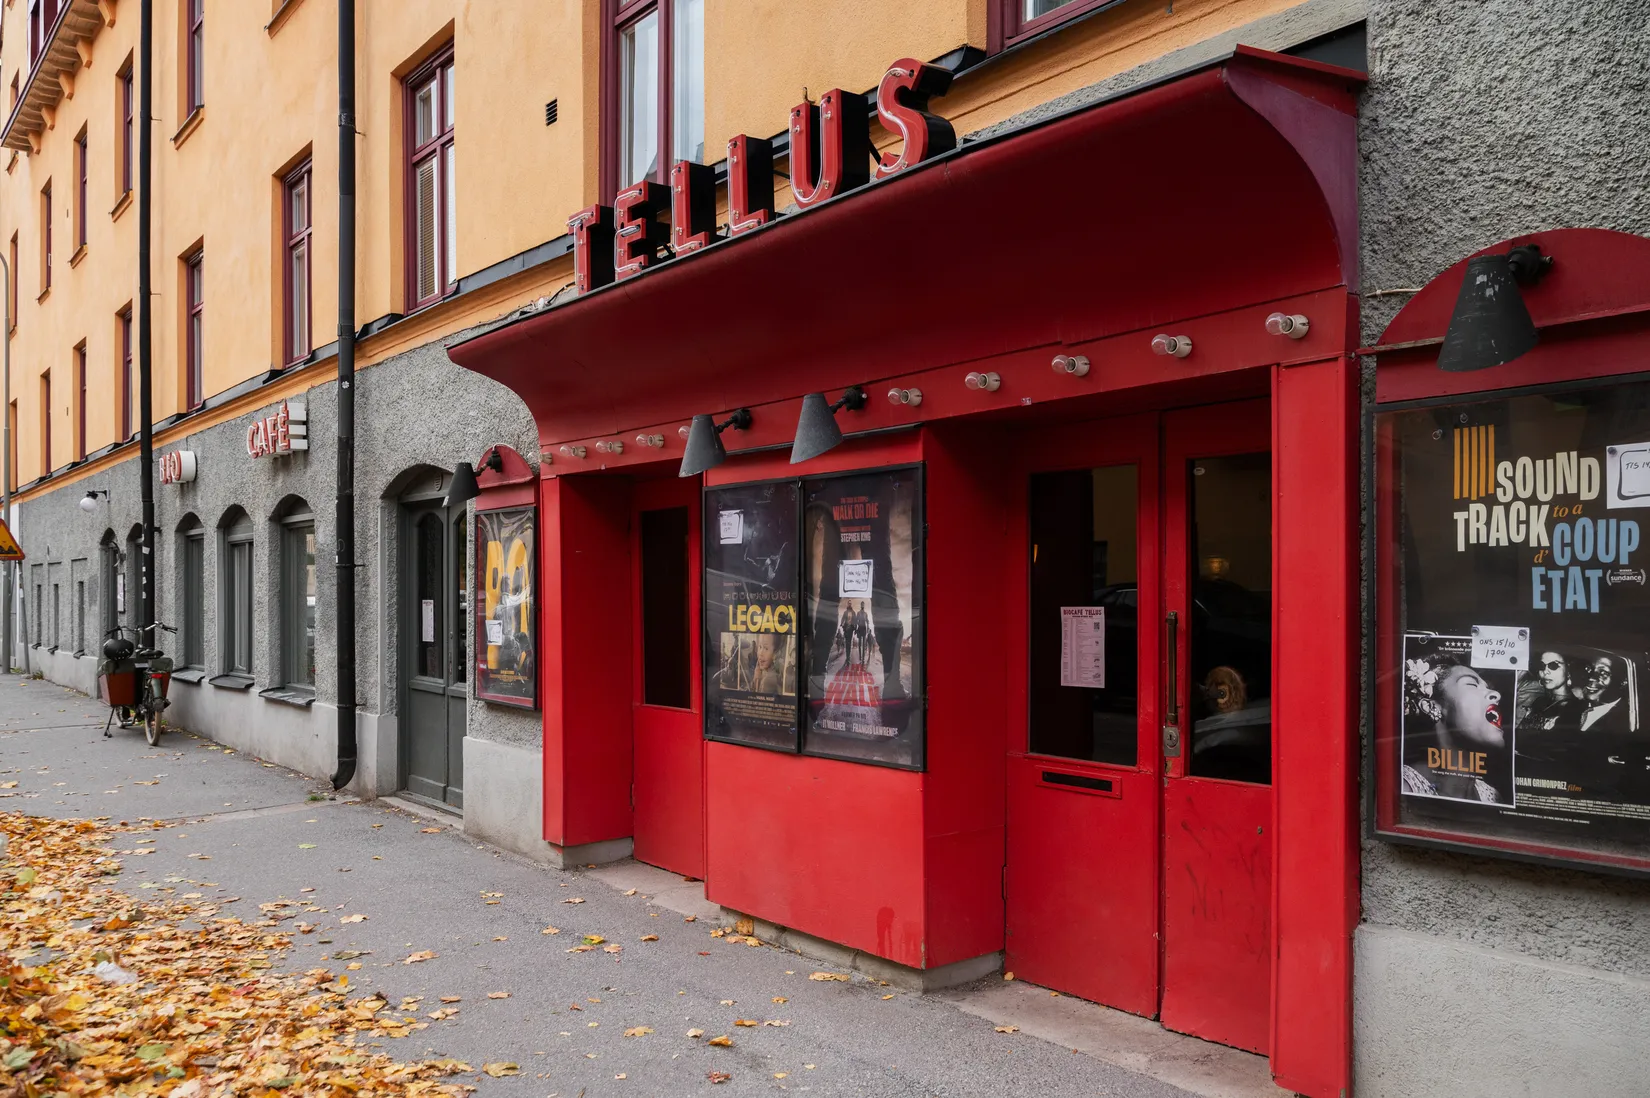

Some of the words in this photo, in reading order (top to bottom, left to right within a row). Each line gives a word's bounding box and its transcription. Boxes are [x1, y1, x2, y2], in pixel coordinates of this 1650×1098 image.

[566, 57, 932, 296] TELLUS
[246, 399, 291, 459] CAFÉ
[159, 449, 183, 485] BIO
[1496, 451, 1600, 502] SOUND
[1642, 461, 1650, 469] 14
[833, 504, 854, 521] WALK
[854, 503, 865, 519] OR
[866, 502, 879, 519] DIE
[1453, 501, 1550, 552] TRACK
[1553, 504, 1569, 518] to
[1572, 504, 1584, 515] a
[1553, 517, 1640, 567] COUP
[1531, 566, 1602, 613] ETAT
[729, 604, 797, 634] LEGACY
[1495, 638, 1516, 649] 15/10
[834, 670, 875, 685] LONG
[825, 681, 880, 708] WALK
[1427, 747, 1487, 774] BILLIE
[1515, 777, 1531, 788] OHAN
